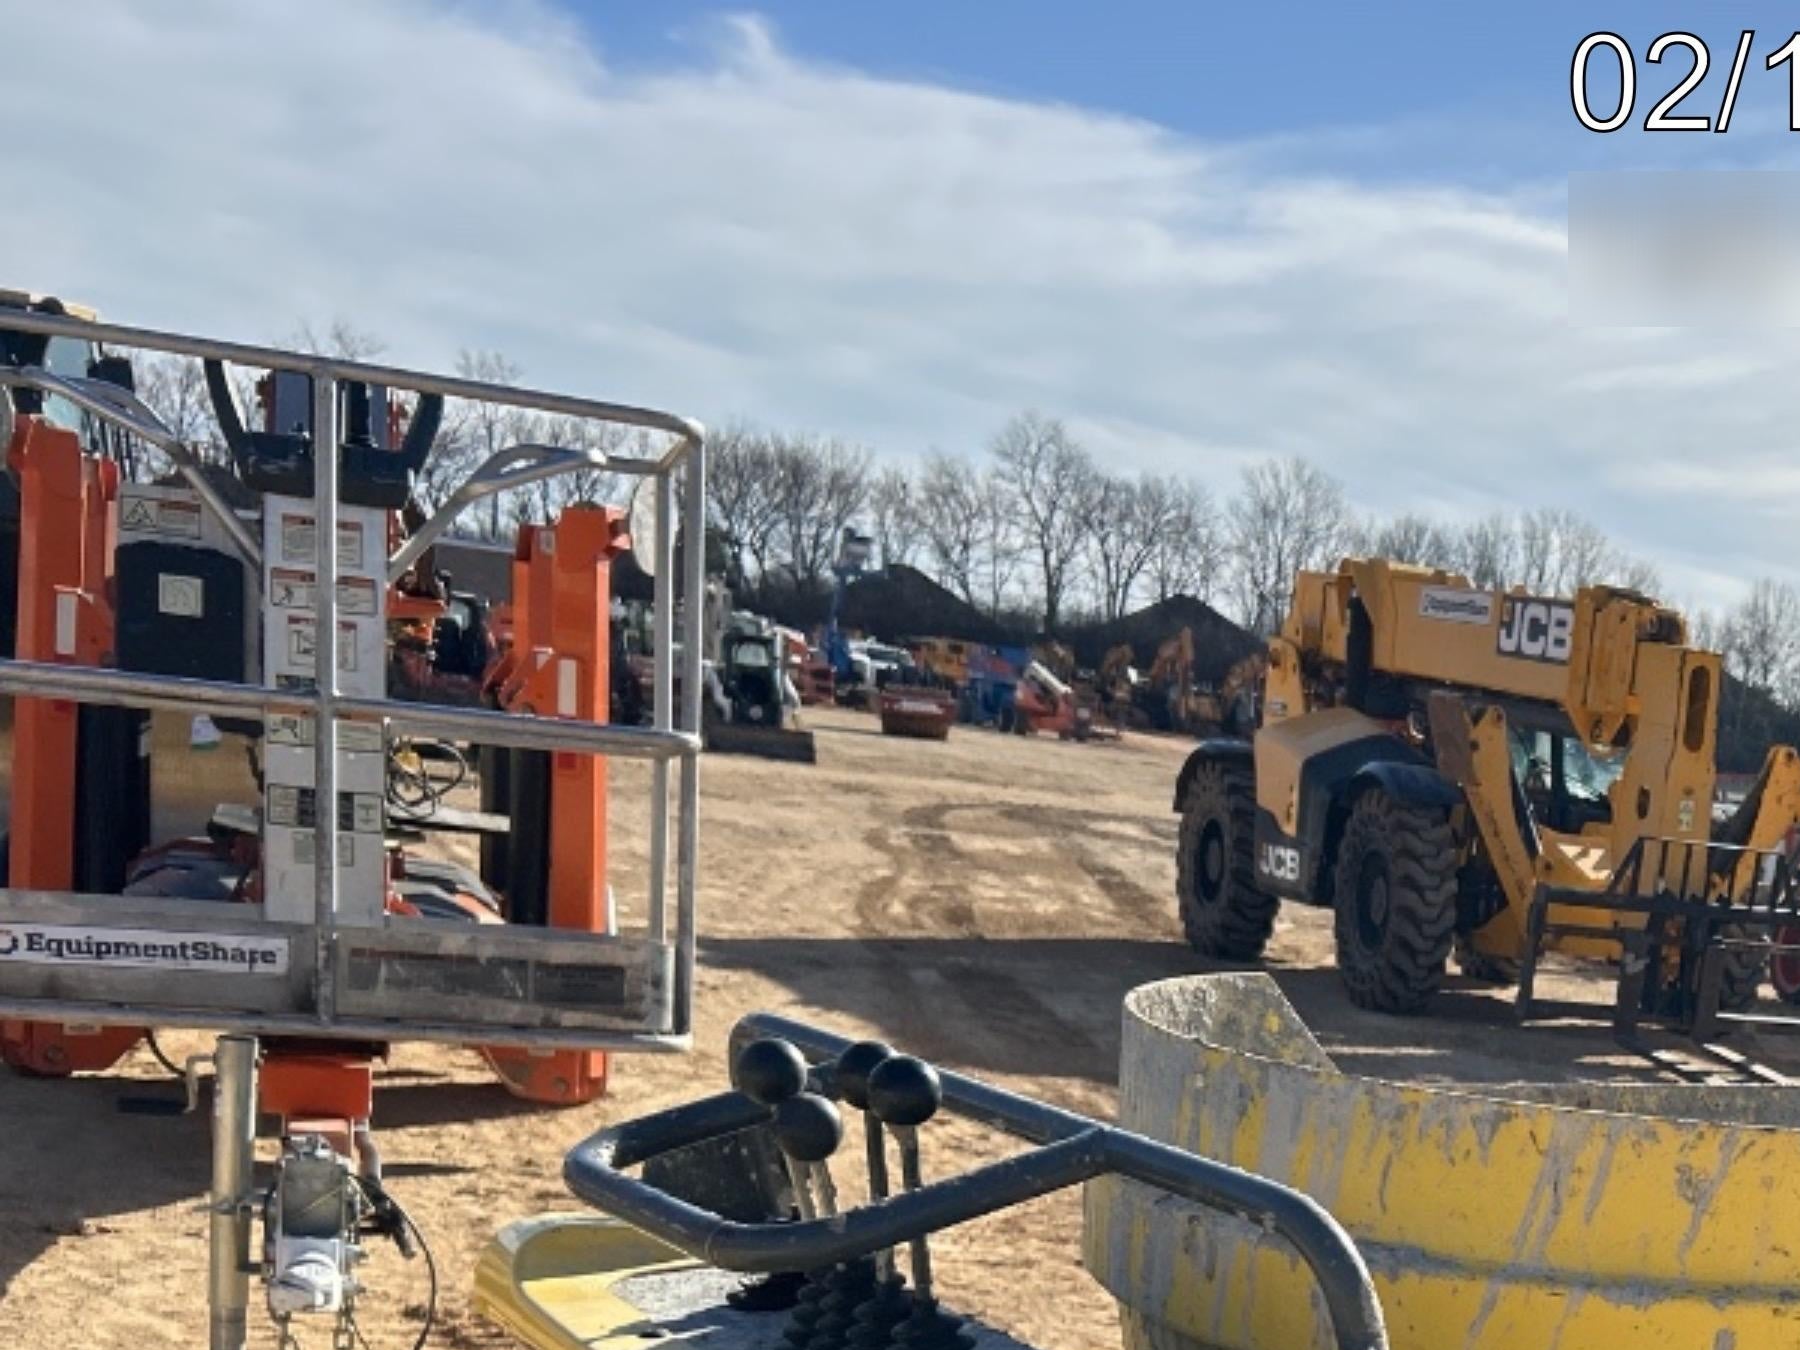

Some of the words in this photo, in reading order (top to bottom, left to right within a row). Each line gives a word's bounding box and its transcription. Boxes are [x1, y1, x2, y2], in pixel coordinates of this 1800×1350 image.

[1499, 598, 1574, 662] JCB
[1260, 843, 1300, 880] JCB
[25, 931, 277, 965] EquipmentShare
